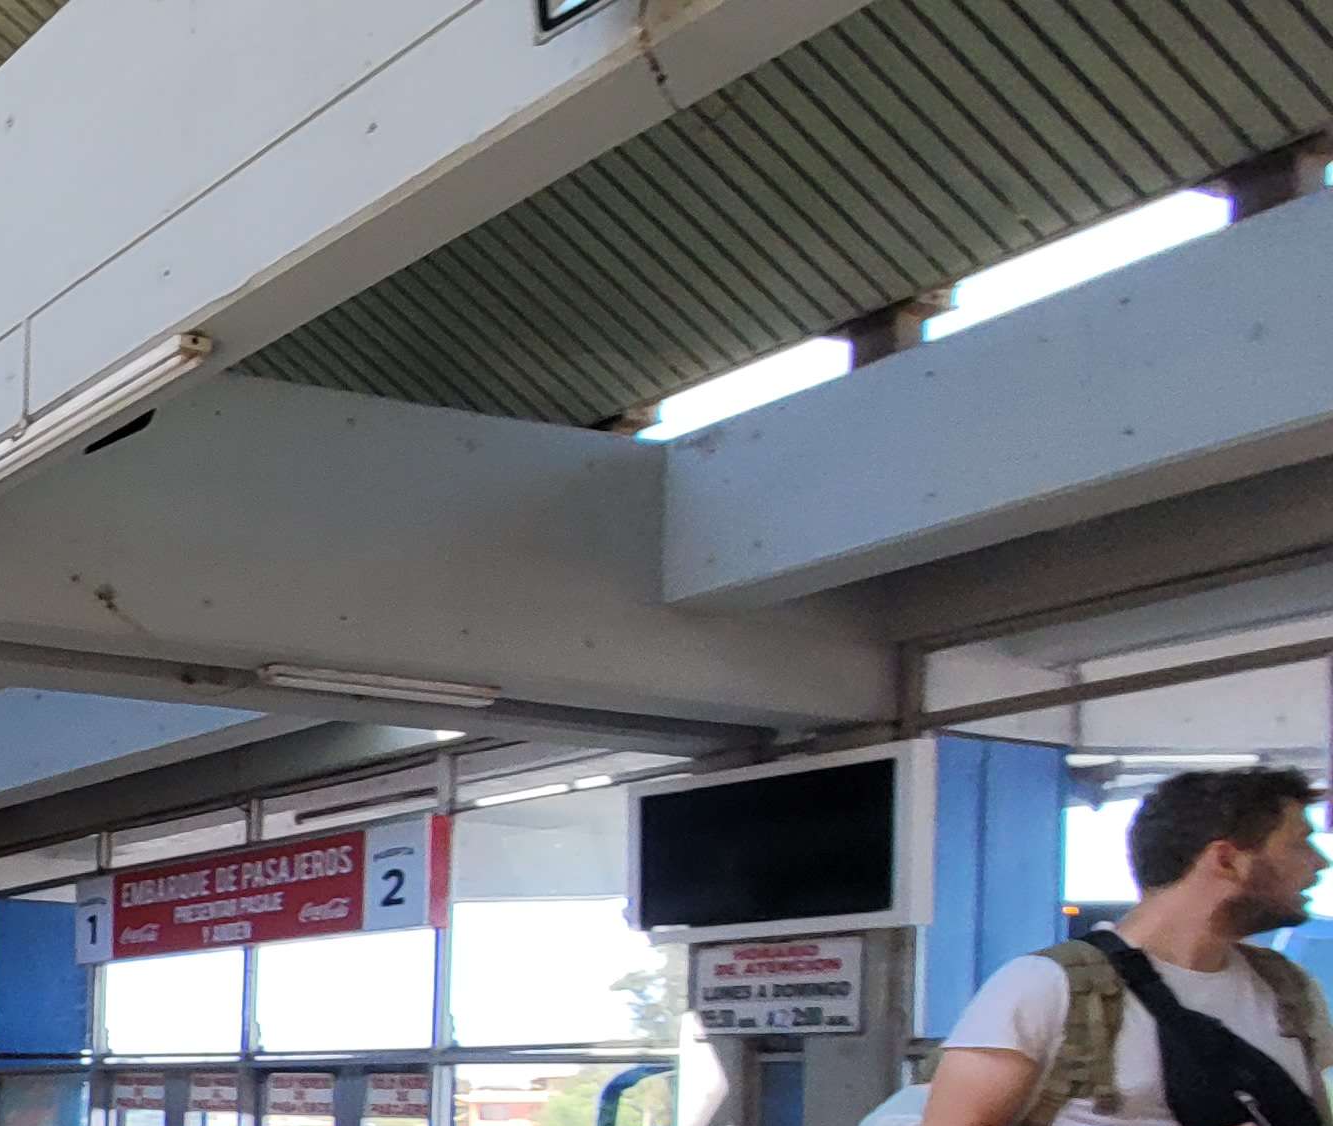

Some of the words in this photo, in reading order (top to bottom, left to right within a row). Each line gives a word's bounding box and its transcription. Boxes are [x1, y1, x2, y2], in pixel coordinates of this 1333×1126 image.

[121, 870, 211, 907] EMBARQUE
[215, 865, 238, 893] DE
[241, 845, 353, 889] PASAJEROS
[380, 868, 406, 907] 2
[87, 914, 98, 945] 1
